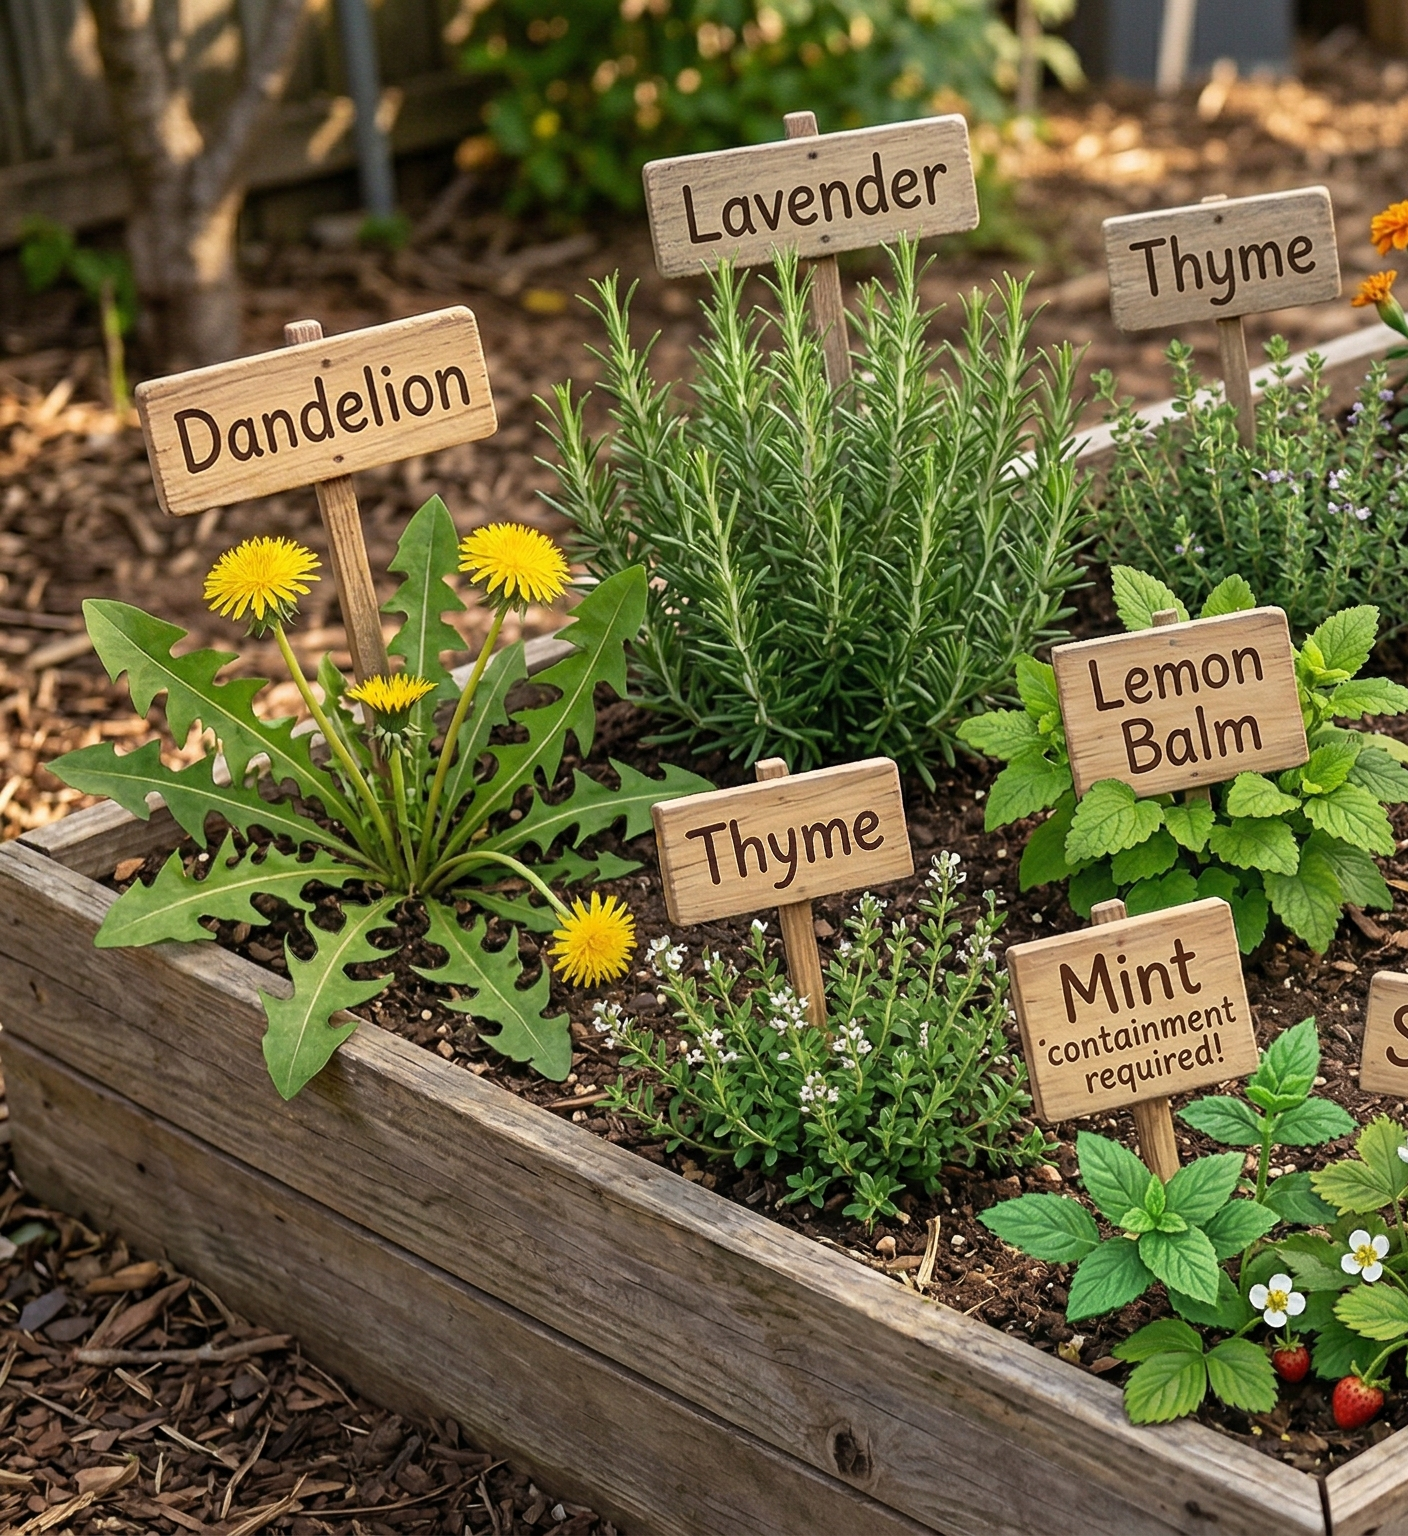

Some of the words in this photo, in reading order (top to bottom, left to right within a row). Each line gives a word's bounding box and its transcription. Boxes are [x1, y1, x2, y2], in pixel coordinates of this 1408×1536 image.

[682, 151, 948, 245] Lavender
[1128, 234, 1316, 307] Thyme
[173, 365, 471, 475] Dandelion
[1088, 647, 1264, 712] Lemon
[1120, 705, 1263, 775] Balm
[684, 810, 885, 890] Thyme
[1059, 938, 1202, 1024] Mint
[1085, 1032, 1224, 1094] required!
